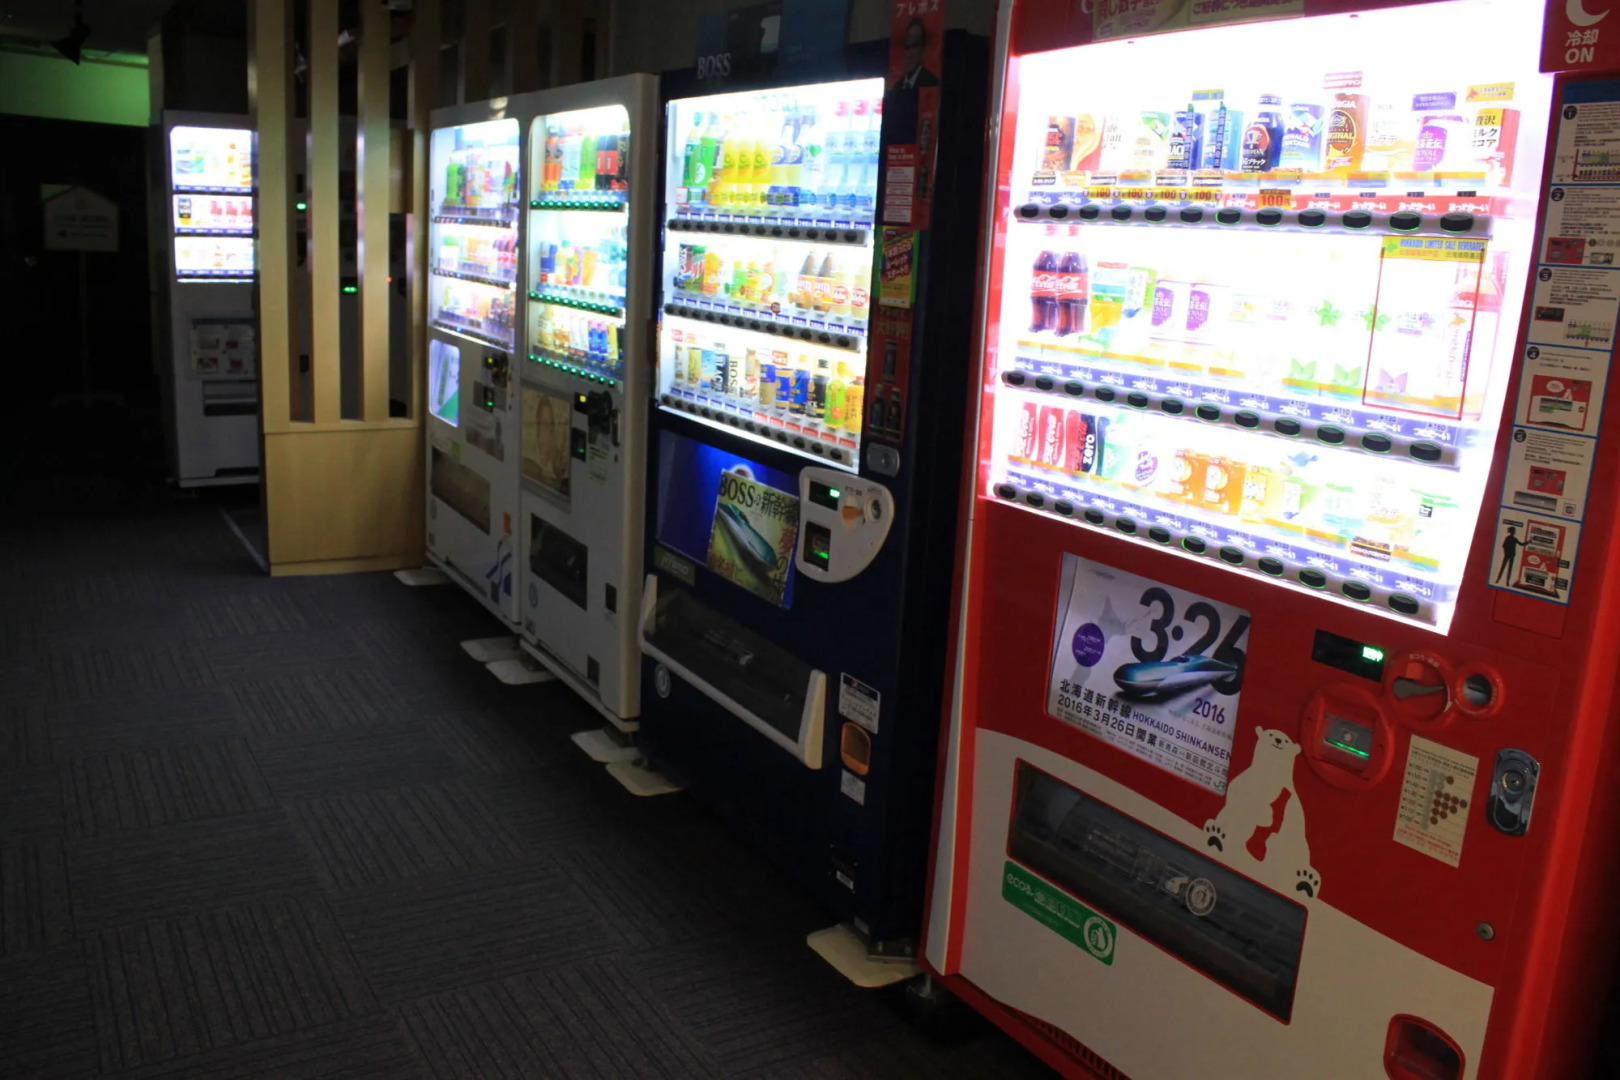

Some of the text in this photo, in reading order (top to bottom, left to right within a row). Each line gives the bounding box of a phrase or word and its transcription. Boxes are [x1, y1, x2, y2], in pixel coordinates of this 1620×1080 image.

[1565, 28, 1599, 46] 冷却
[697, 52, 731, 80] BOSS
[1564, 47, 1594, 64] ON
[1083, 434, 1095, 465] zero
[720, 477, 755, 508] BOSS
[1057, 694, 1158, 748] 2016年3月26日開業
[1059, 678, 1133, 719] 北海道新幹線
[1132, 712, 1175, 737] HOKKAIDO
[1193, 697, 1226, 724] 2016
